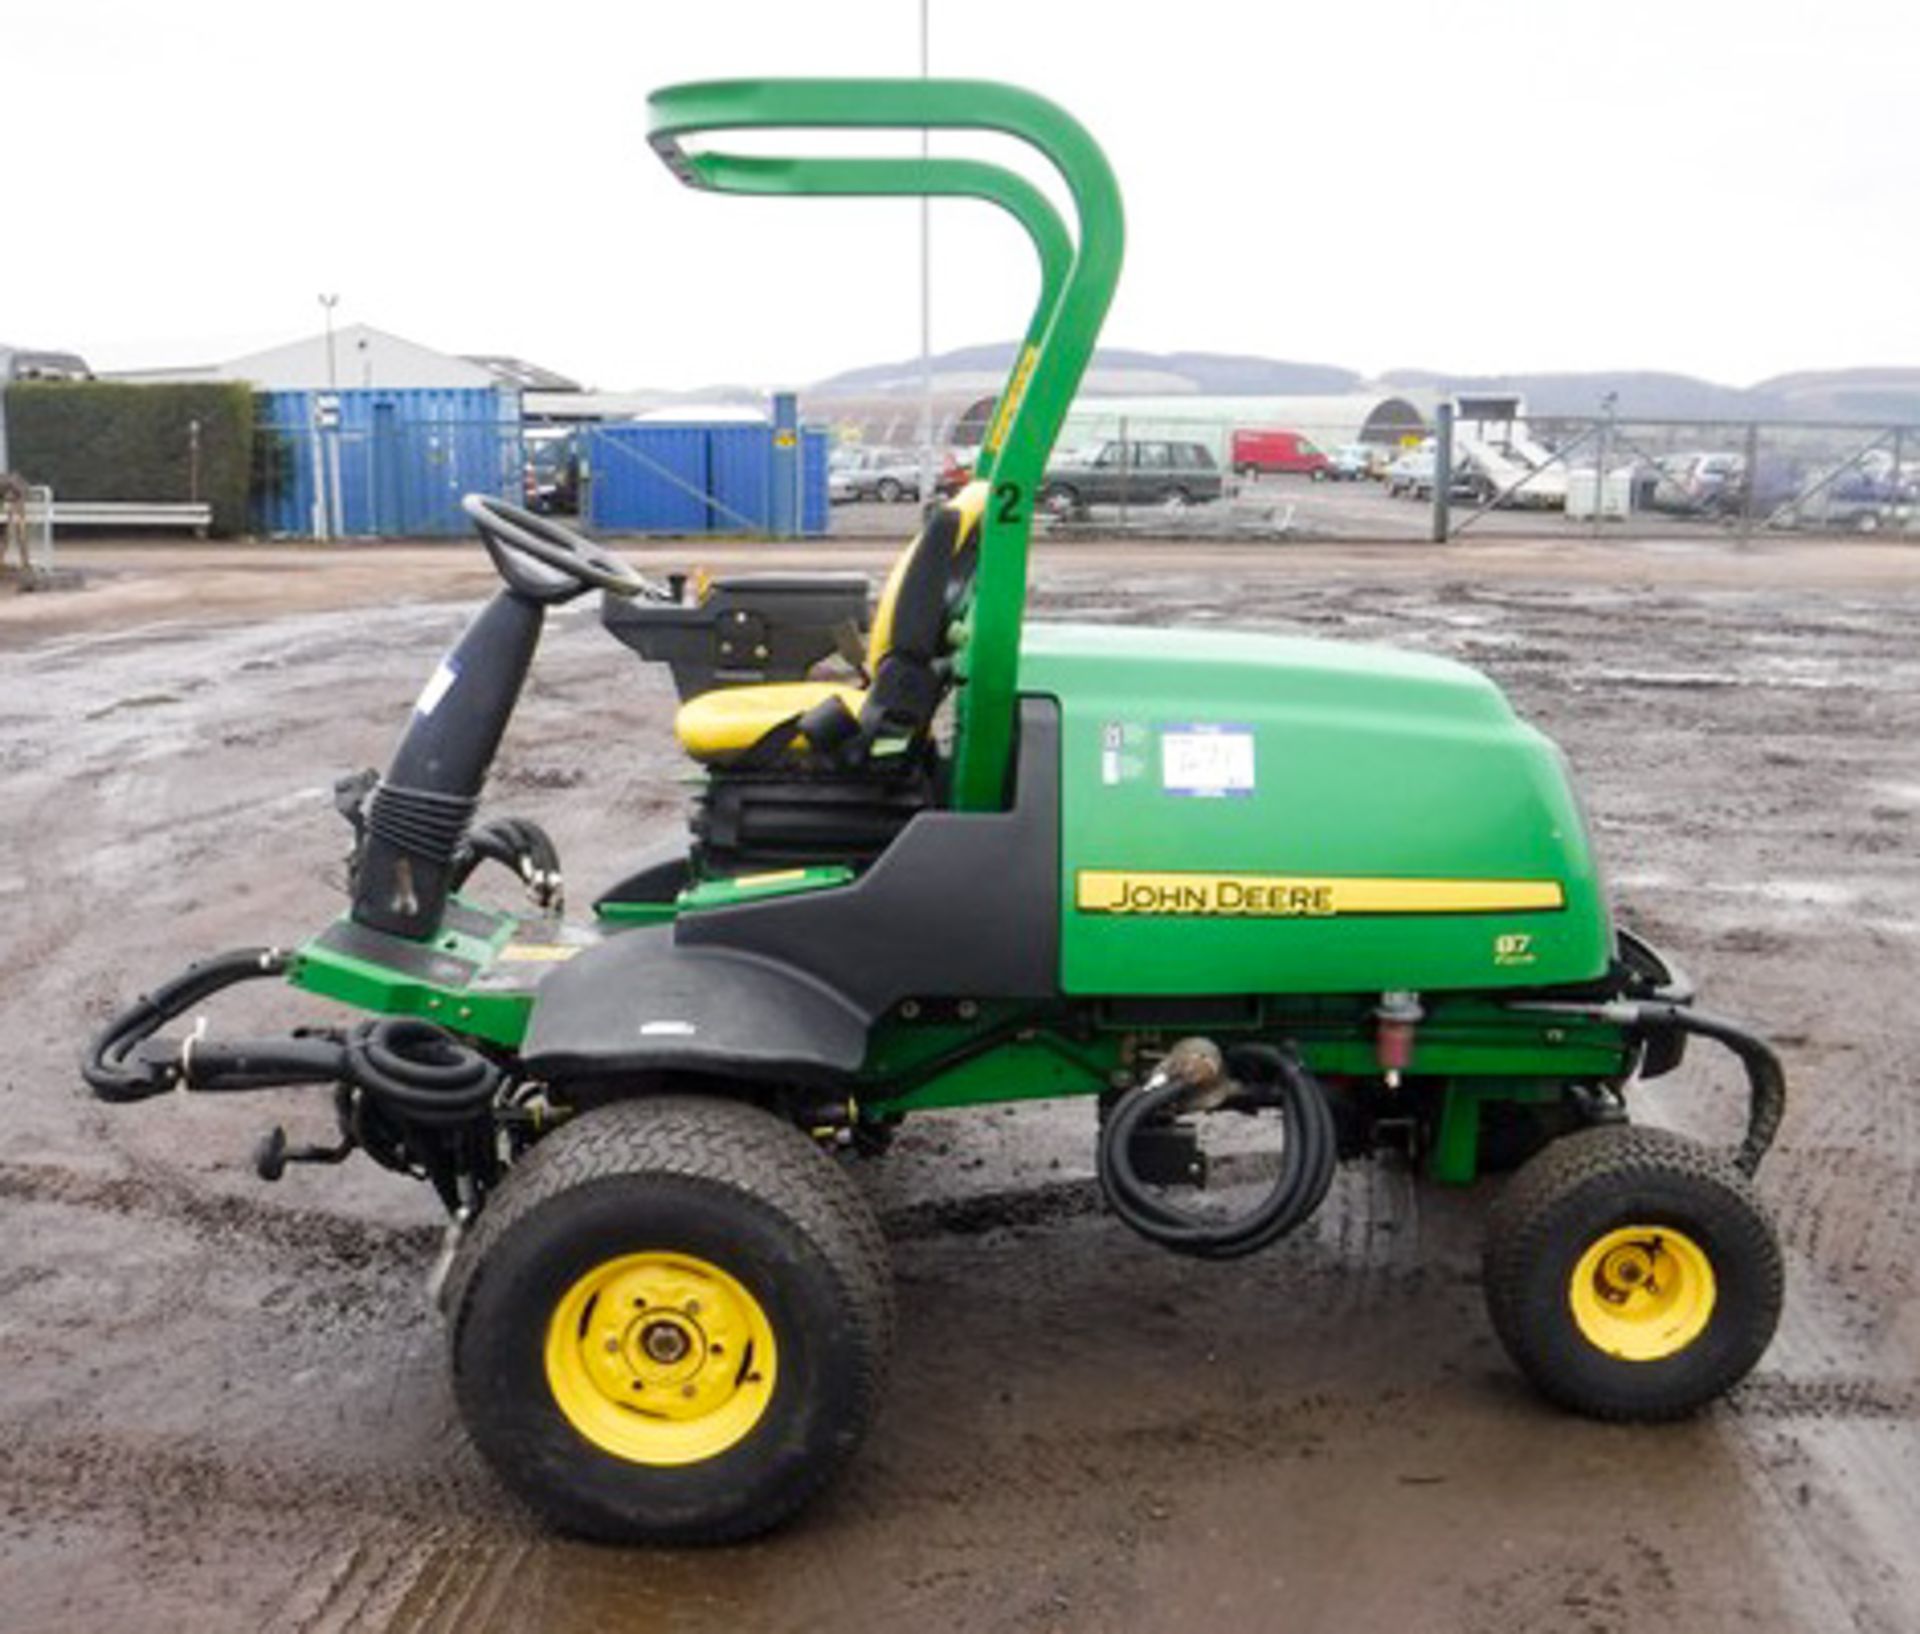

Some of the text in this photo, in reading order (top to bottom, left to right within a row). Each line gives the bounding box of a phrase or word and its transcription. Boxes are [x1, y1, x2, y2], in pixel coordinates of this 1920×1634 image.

[996, 481, 1021, 523] 2
[1110, 880, 1334, 912] JOHN DEERE
